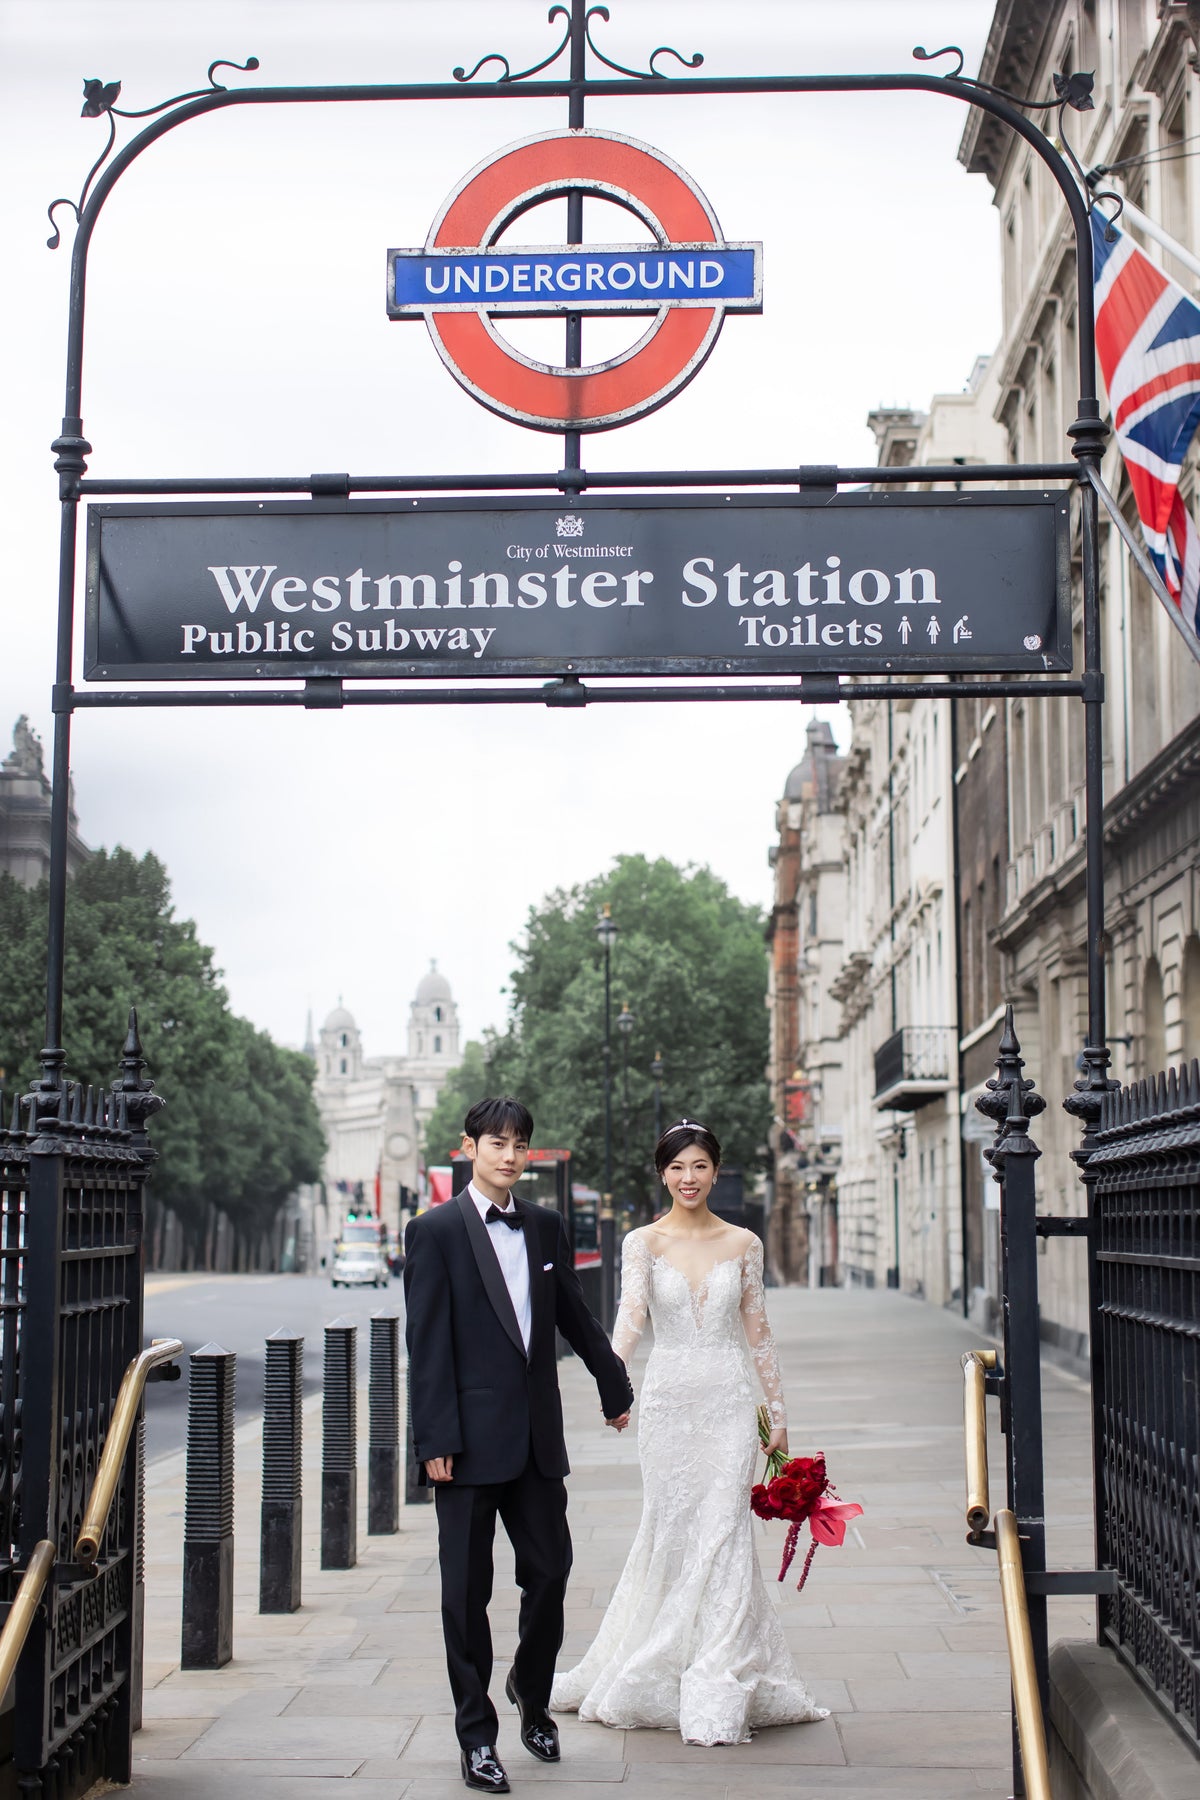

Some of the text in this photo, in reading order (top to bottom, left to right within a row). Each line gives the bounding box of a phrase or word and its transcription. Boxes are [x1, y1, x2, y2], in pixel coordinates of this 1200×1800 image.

[425, 260, 725, 294] UNDERGROUND
[506, 543, 634, 562] City of Westminster
[207, 556, 942, 614] Westminster Station
[180, 618, 497, 659] Public Subway
[738, 613, 883, 647] Toilets
